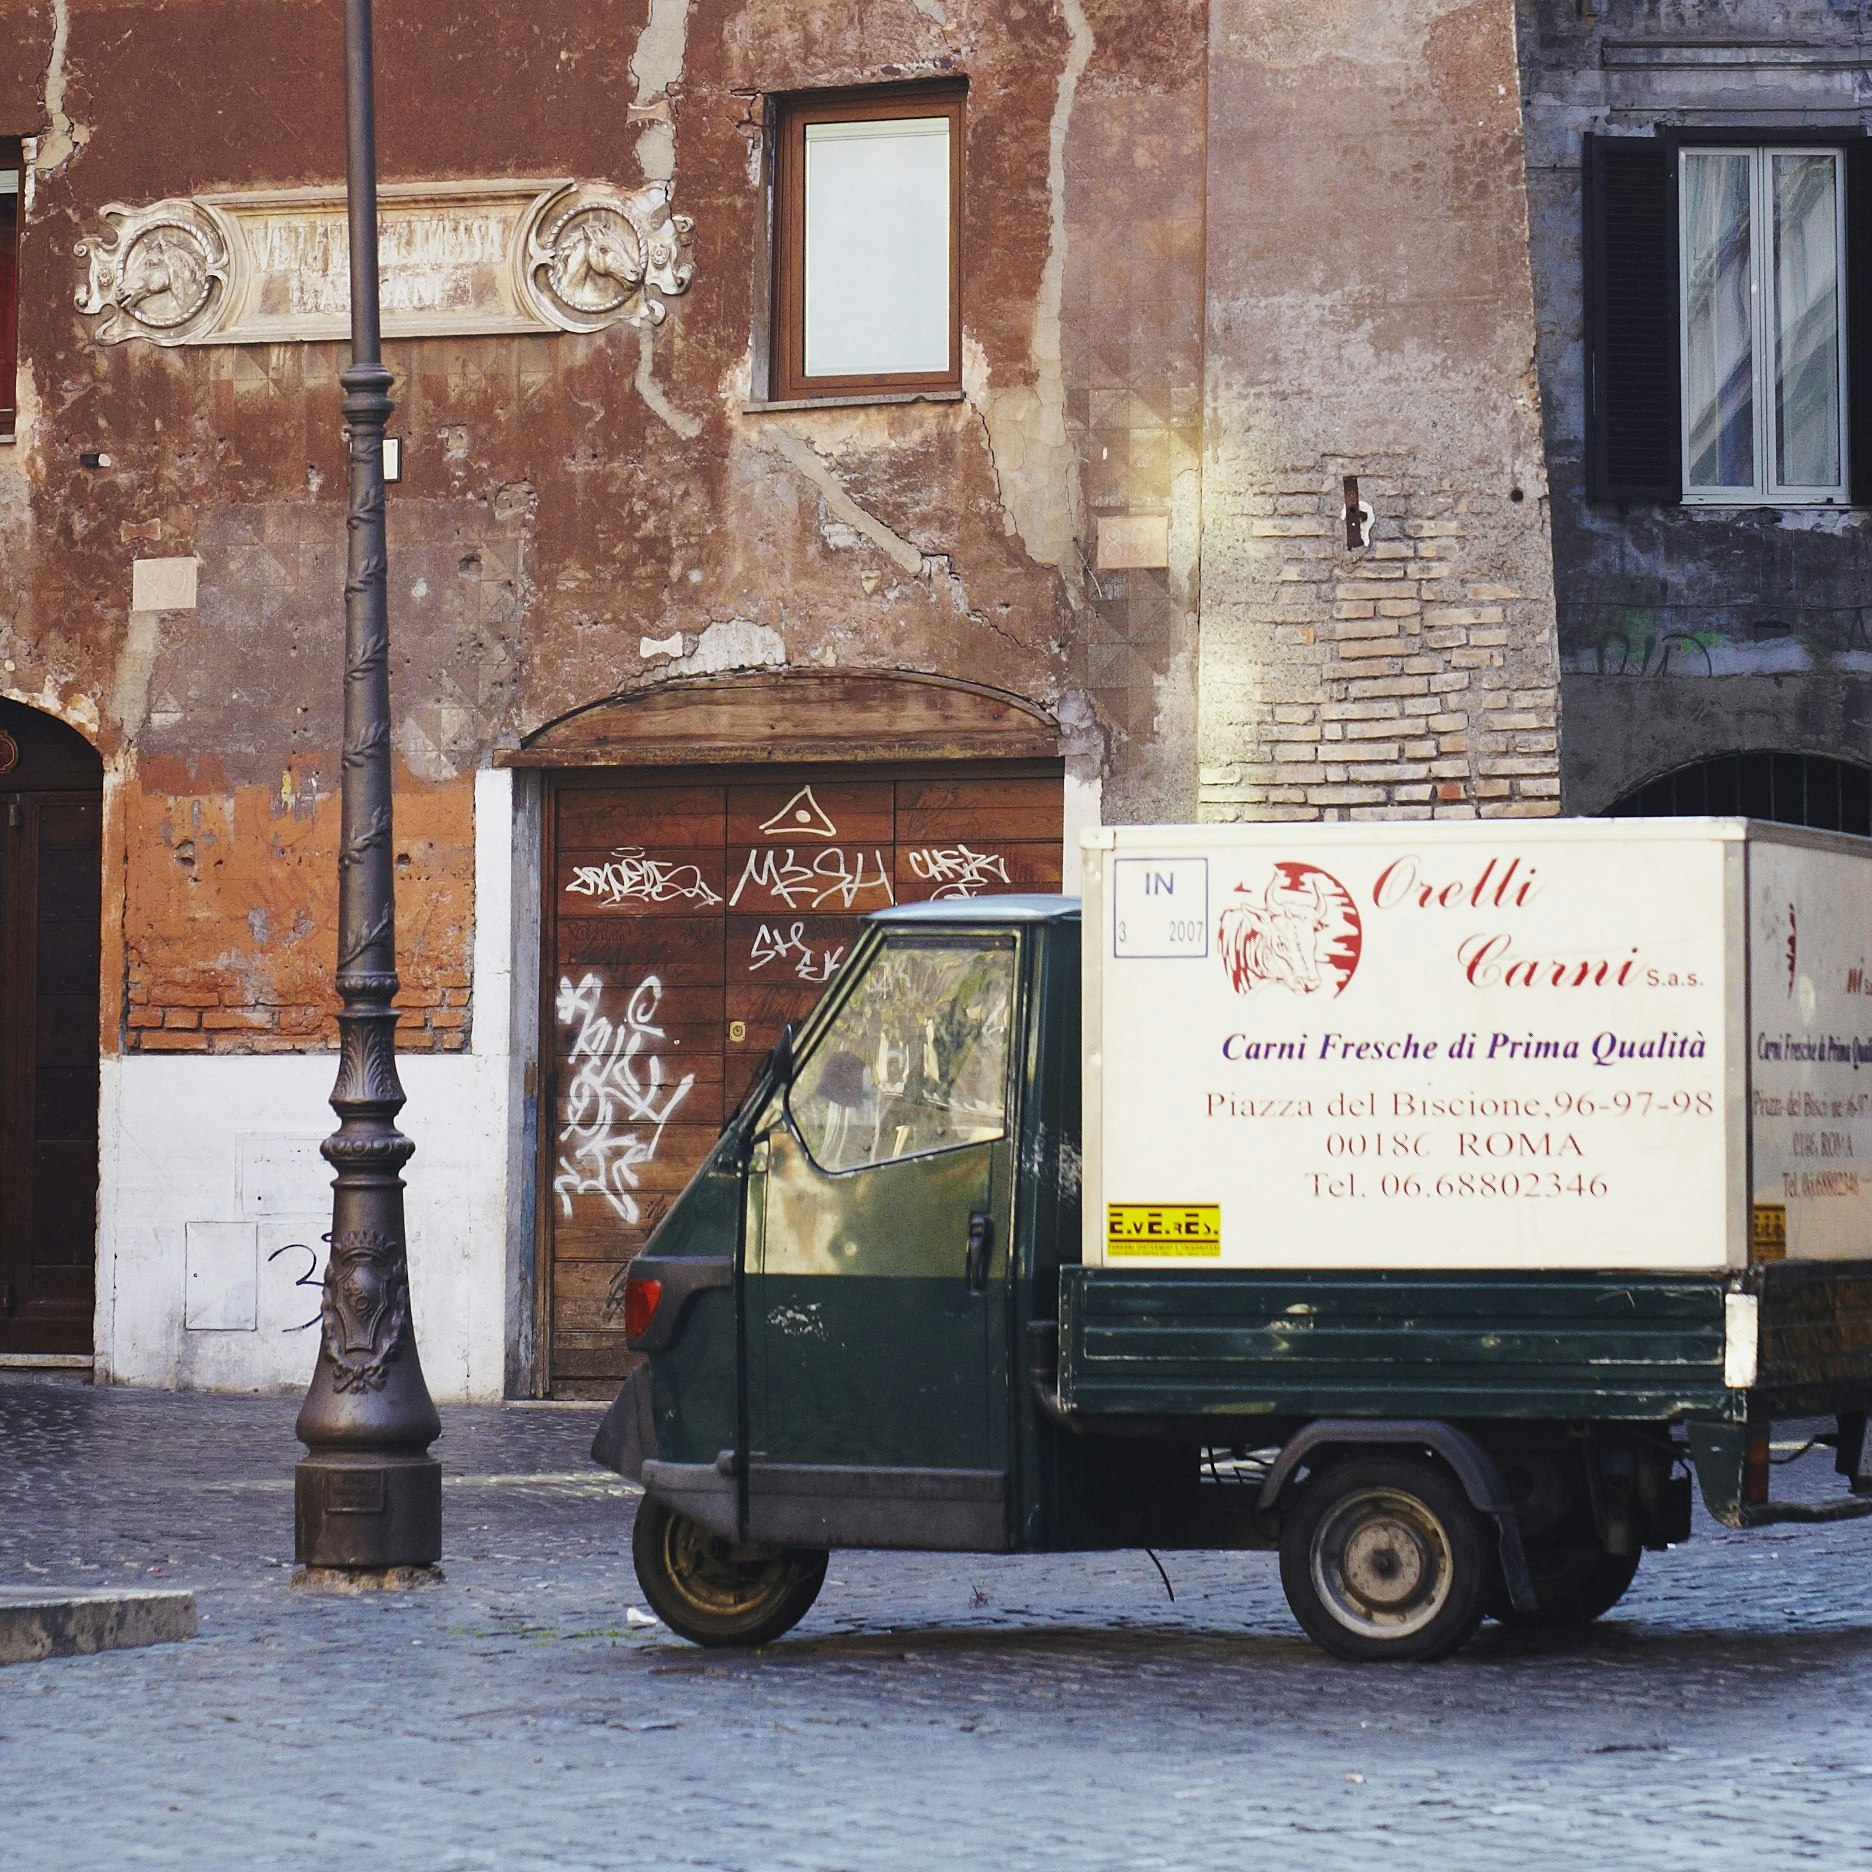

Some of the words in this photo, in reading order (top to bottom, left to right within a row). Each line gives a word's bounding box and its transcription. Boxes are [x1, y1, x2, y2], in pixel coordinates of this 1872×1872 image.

[1145, 872, 1174, 895] IN
[1372, 854, 1542, 909] Orelli
[1118, 921, 1127, 943] 3
[1169, 920, 1204, 942] 2007
[1457, 932, 1641, 989] Carni
[1647, 969, 1704, 987] S.a.s.
[1222, 1032, 1308, 1061] Carni
[1318, 1032, 1438, 1060] Fresche
[1448, 1032, 1477, 1059] di
[1486, 1031, 1579, 1060] Prima
[1591, 1030, 1706, 1066] Qualità
[1207, 1091, 1313, 1117] Piazza
[1327, 1091, 1376, 1117] del
[1459, 1131, 1585, 1157] ROMA
[1305, 1172, 1365, 1198] Tel.
[1381, 1172, 1608, 1198] 06.68802346
